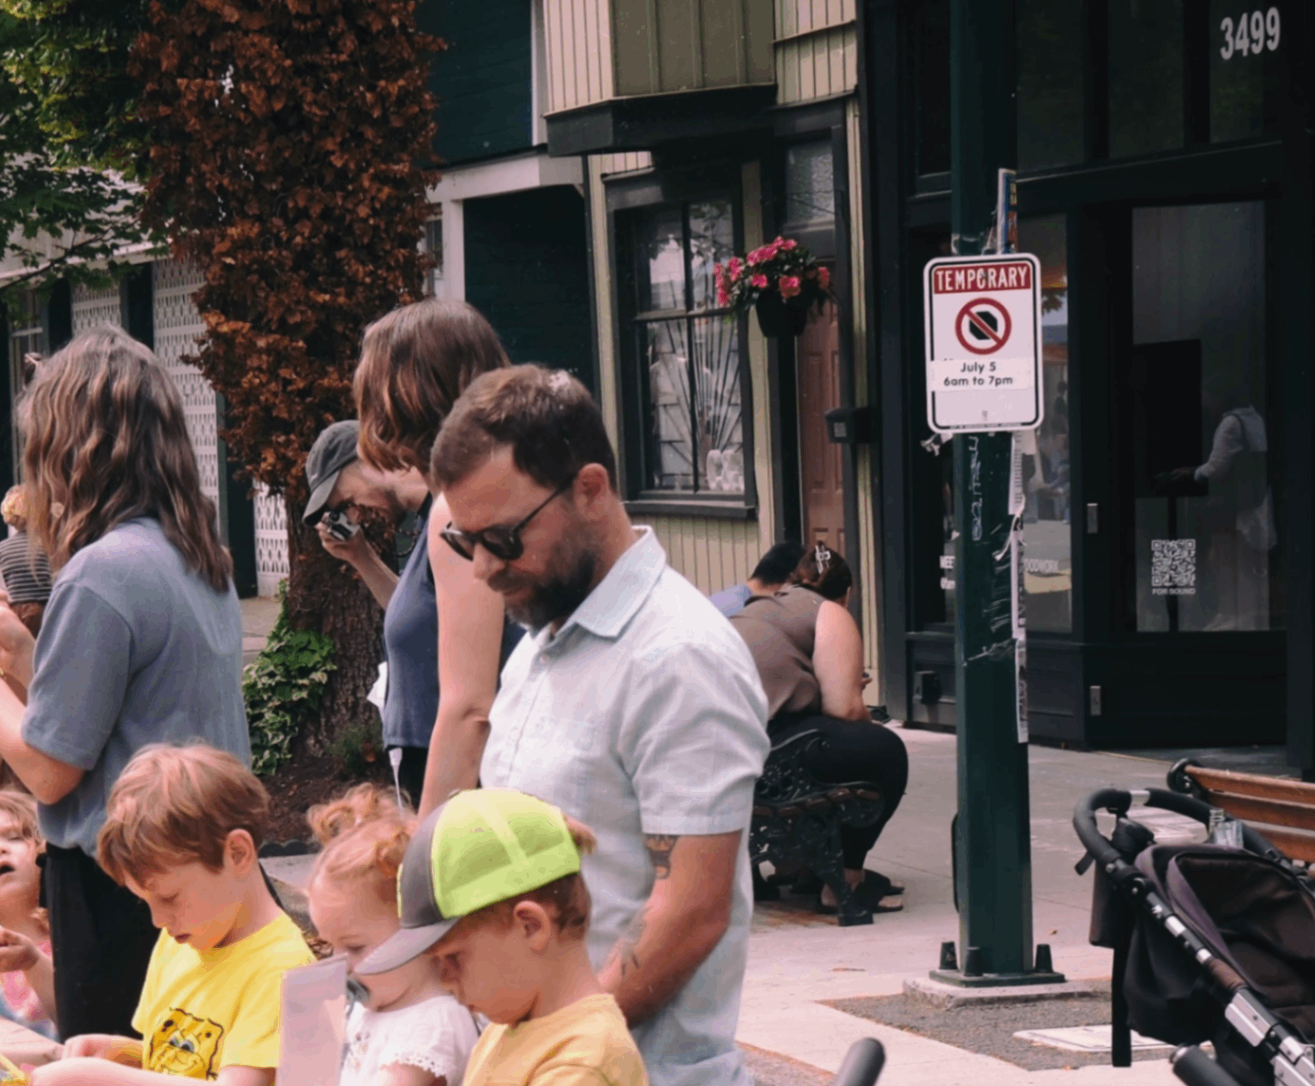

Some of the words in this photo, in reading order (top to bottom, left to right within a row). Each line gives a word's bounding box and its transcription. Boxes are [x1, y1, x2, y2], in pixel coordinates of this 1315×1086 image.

[1220, 6, 1281, 61] 3499
[936, 265, 1029, 292] TEMPORARY
[960, 361, 985, 374] July
[988, 361, 997, 372] 5
[943, 376, 969, 386] 6am
[973, 375, 984, 386] to
[988, 376, 1013, 388] 7pm
[1151, 587, 1168, 596] FOR
[1169, 587, 1196, 596] SOUND
